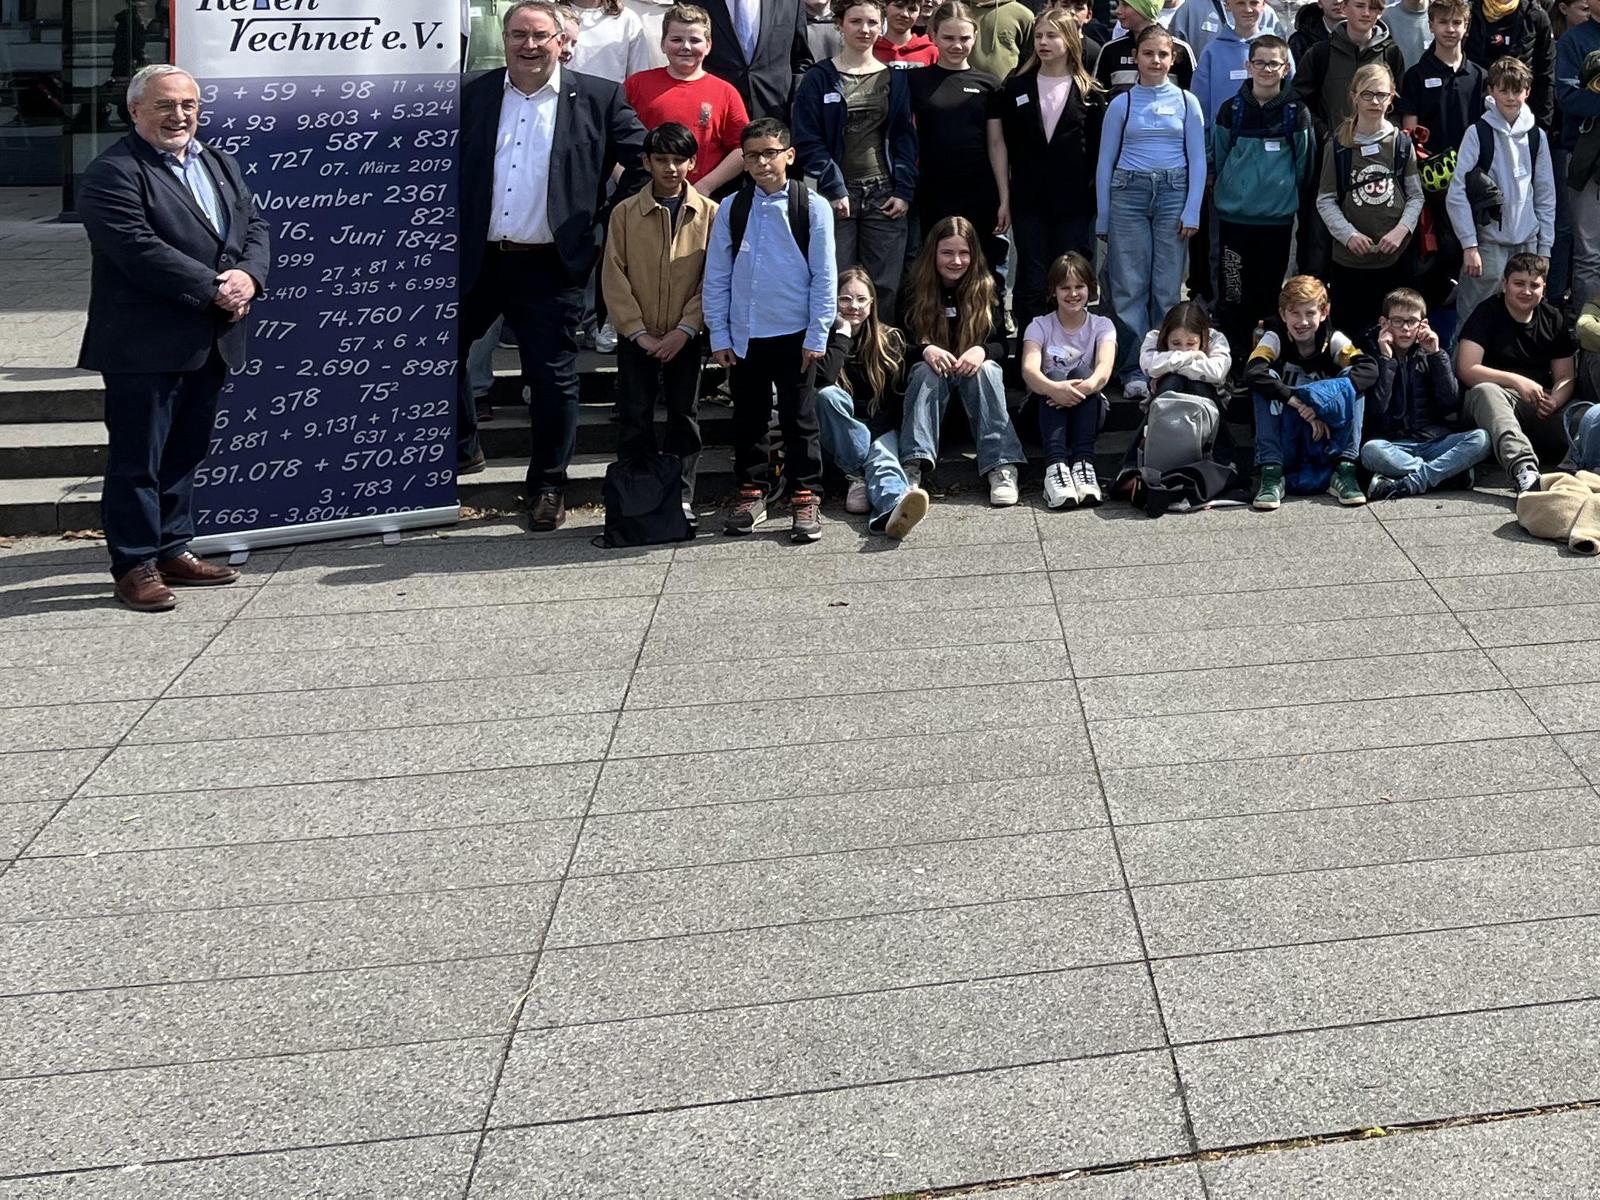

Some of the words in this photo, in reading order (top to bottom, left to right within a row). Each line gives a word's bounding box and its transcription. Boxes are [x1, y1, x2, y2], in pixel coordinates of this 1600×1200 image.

[381, 21, 444, 51] e.V.
[261, 82, 297, 101] 59
[340, 81, 375, 99] 98
[391, 80, 407, 93] 11
[433, 79, 457, 93] 49
[245, 114, 276, 131] 93
[297, 110, 359, 130] 9.803
[391, 100, 454, 120] 5.324
[325, 131, 379, 152] 587
[413, 129, 459, 148] 831
[268, 148, 313, 171] 727
[319, 162, 350, 177] 07.
[358, 161, 401, 175] März
[407, 158, 452, 173] 2019
[250, 188, 373, 210] November
[383, 183, 448, 204] 2361
[279, 221, 315, 241] 16.
[330, 225, 387, 247] Juni
[394, 229, 458, 252] 1842
[276, 253, 315, 268] 999
[321, 266, 344, 282] 27
[368, 260, 388, 274] 81
[413, 254, 432, 267] 16
[331, 281, 380, 296] 3.315
[405, 277, 457, 291] 6.993
[318, 306, 402, 328] 74.760
[435, 302, 459, 320] 15
[255, 320, 297, 340] 117
[338, 337, 366, 353] 57
[393, 333, 407, 348] 6
[436, 331, 450, 345] 4
[296, 358, 370, 377] 2.690
[402, 358, 458, 376] 8981
[270, 388, 321, 415] 378
[304, 414, 358, 439] 9.131
[353, 429, 388, 446] 631
[412, 426, 451, 442] 294
[192, 459, 303, 488] 591.078
[341, 443, 445, 472] 570.819
[424, 469, 453, 488] 39
[196, 509, 260, 526] 7.663
